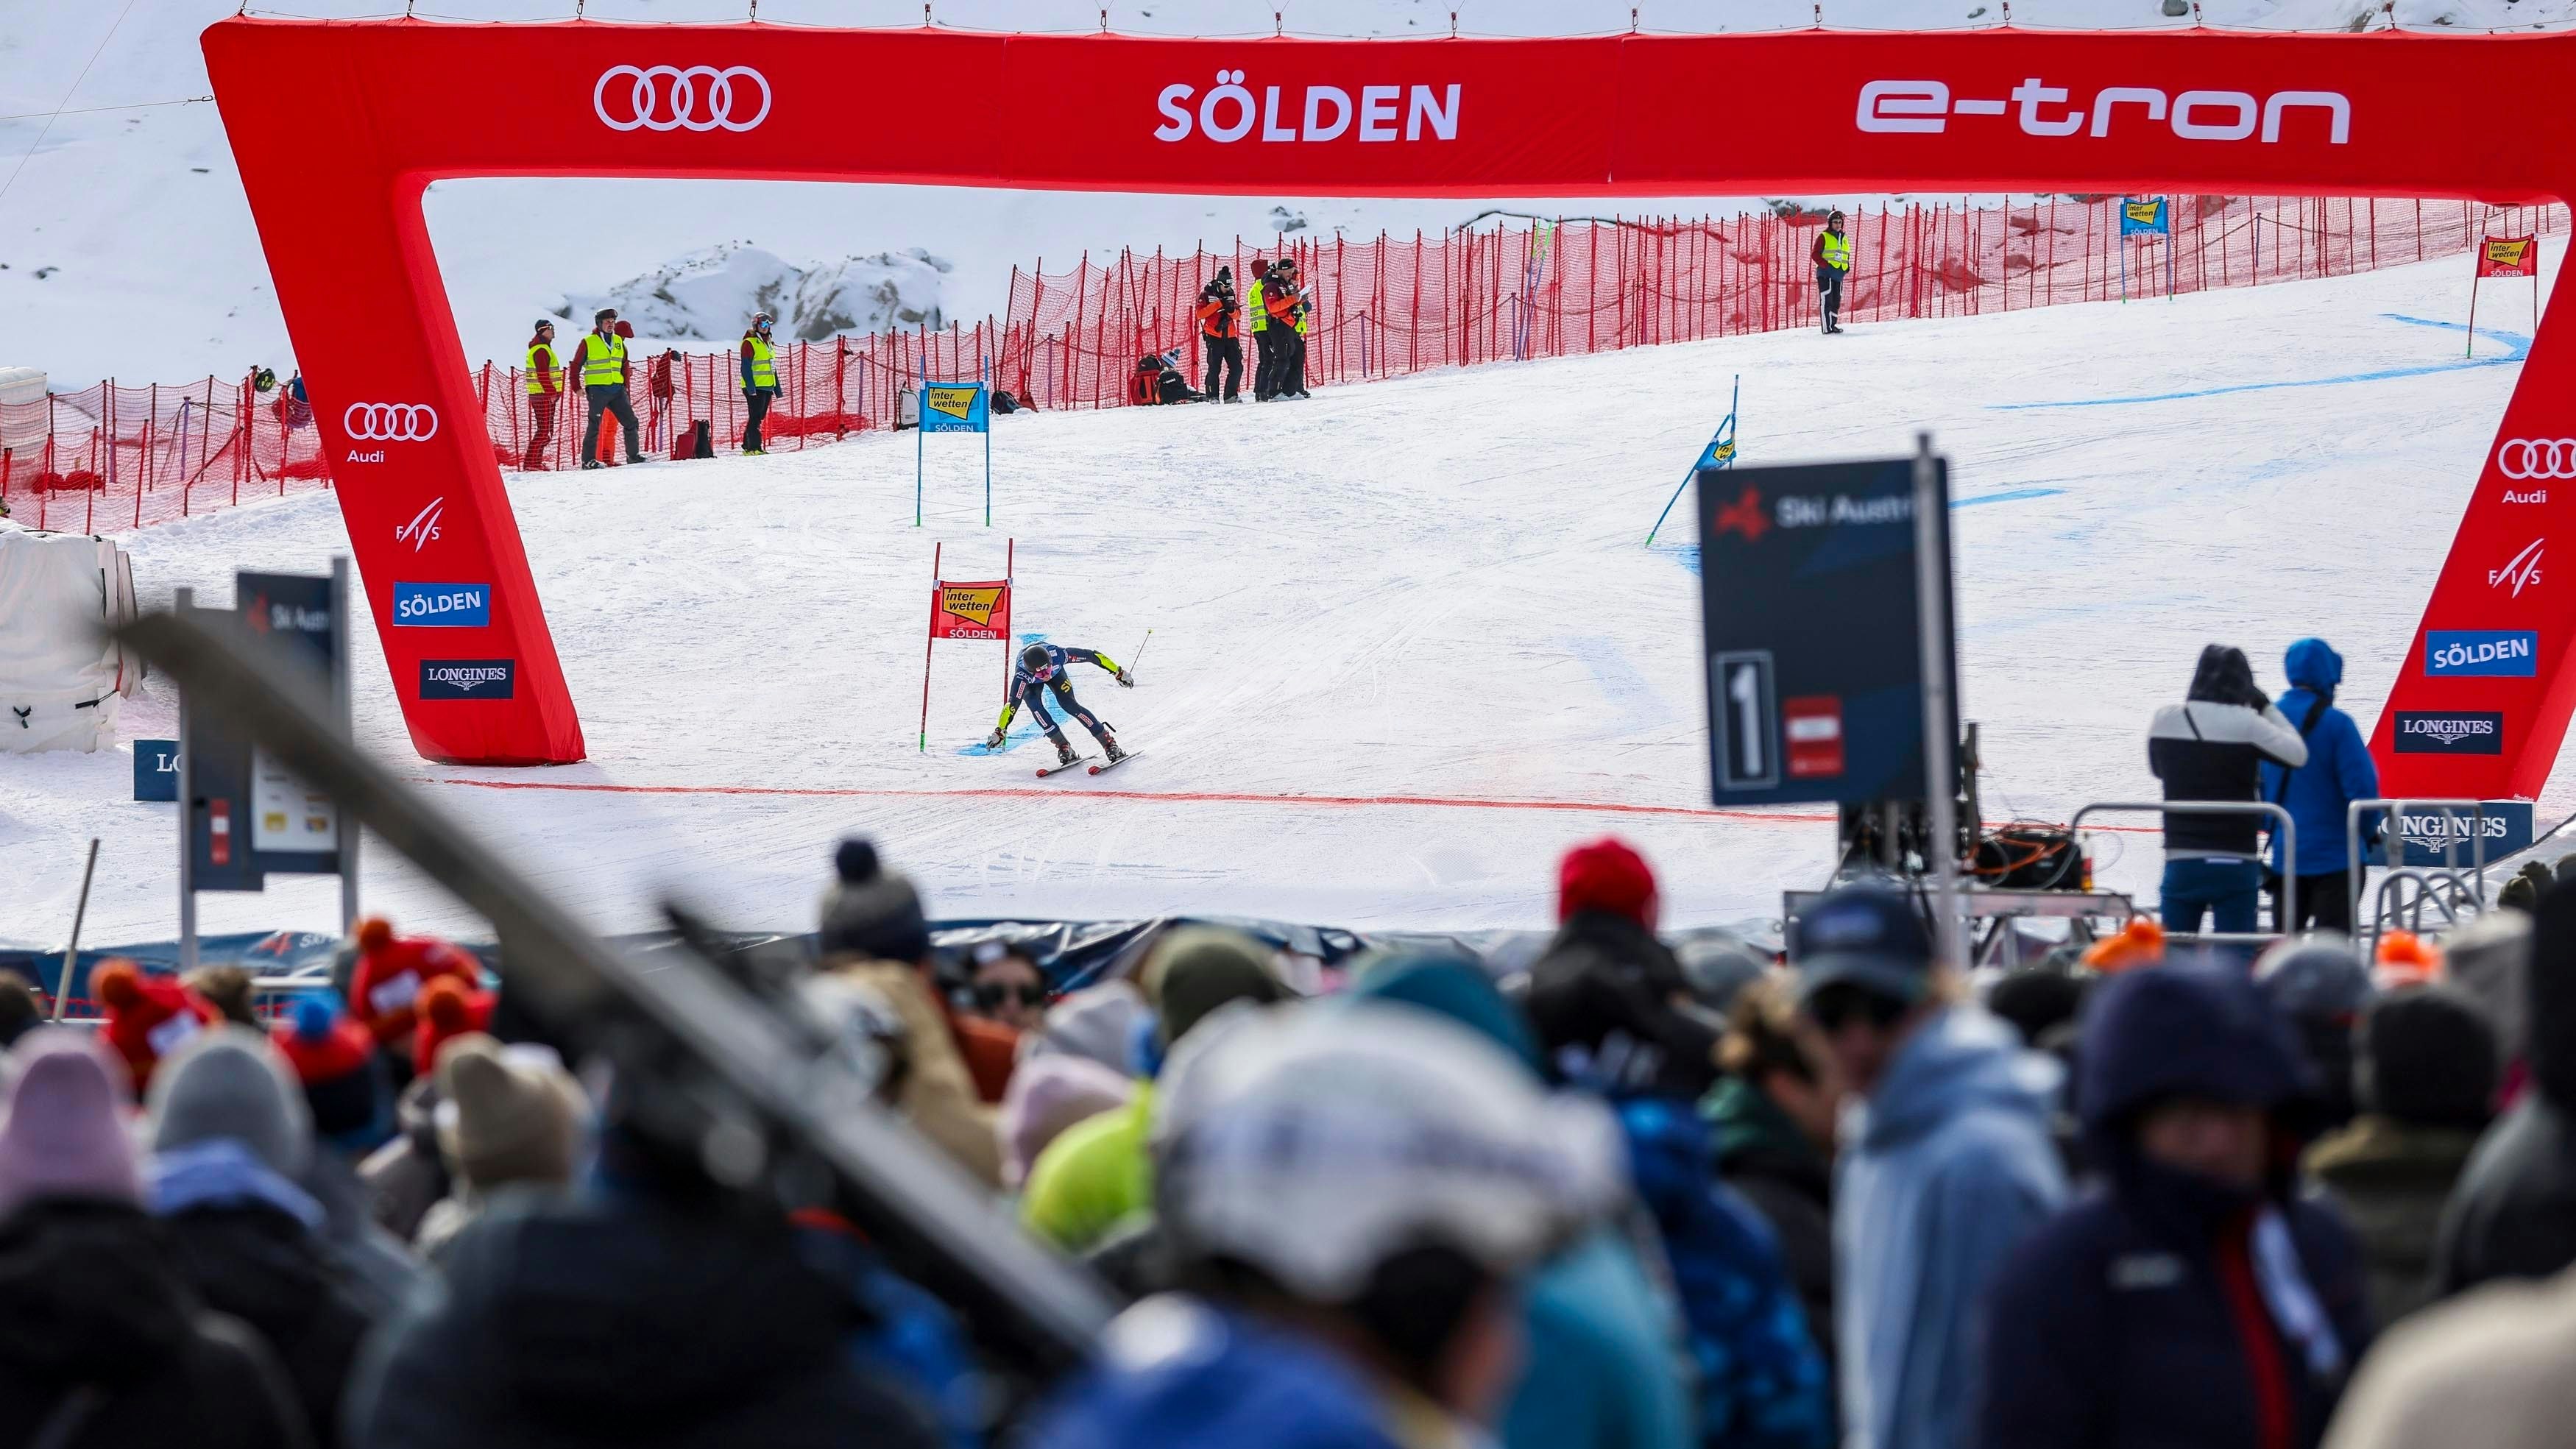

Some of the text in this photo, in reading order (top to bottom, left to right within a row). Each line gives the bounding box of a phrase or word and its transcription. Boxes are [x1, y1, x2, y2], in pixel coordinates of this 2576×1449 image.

[1153, 69, 1462, 143] SÖLDEN
[1855, 78, 2351, 144] e-tron
[2491, 242, 2511, 251] inter
[931, 389, 955, 400] inter
[934, 400, 968, 408] wetten
[935, 423, 974, 432] SÖLDEN
[347, 450, 385, 464] Audi
[2502, 489, 2547, 504] Audi
[946, 589, 975, 600] inter
[400, 591, 481, 618] SÖLDEN
[949, 602, 990, 611] wetten
[949, 628, 997, 639] SÖLDEN
[2434, 638, 2529, 669] SÖLDEN
[428, 667, 506, 681] LONGINES
[2403, 720, 2494, 734] LONGINES
[2378, 815, 2508, 838] NGINES
